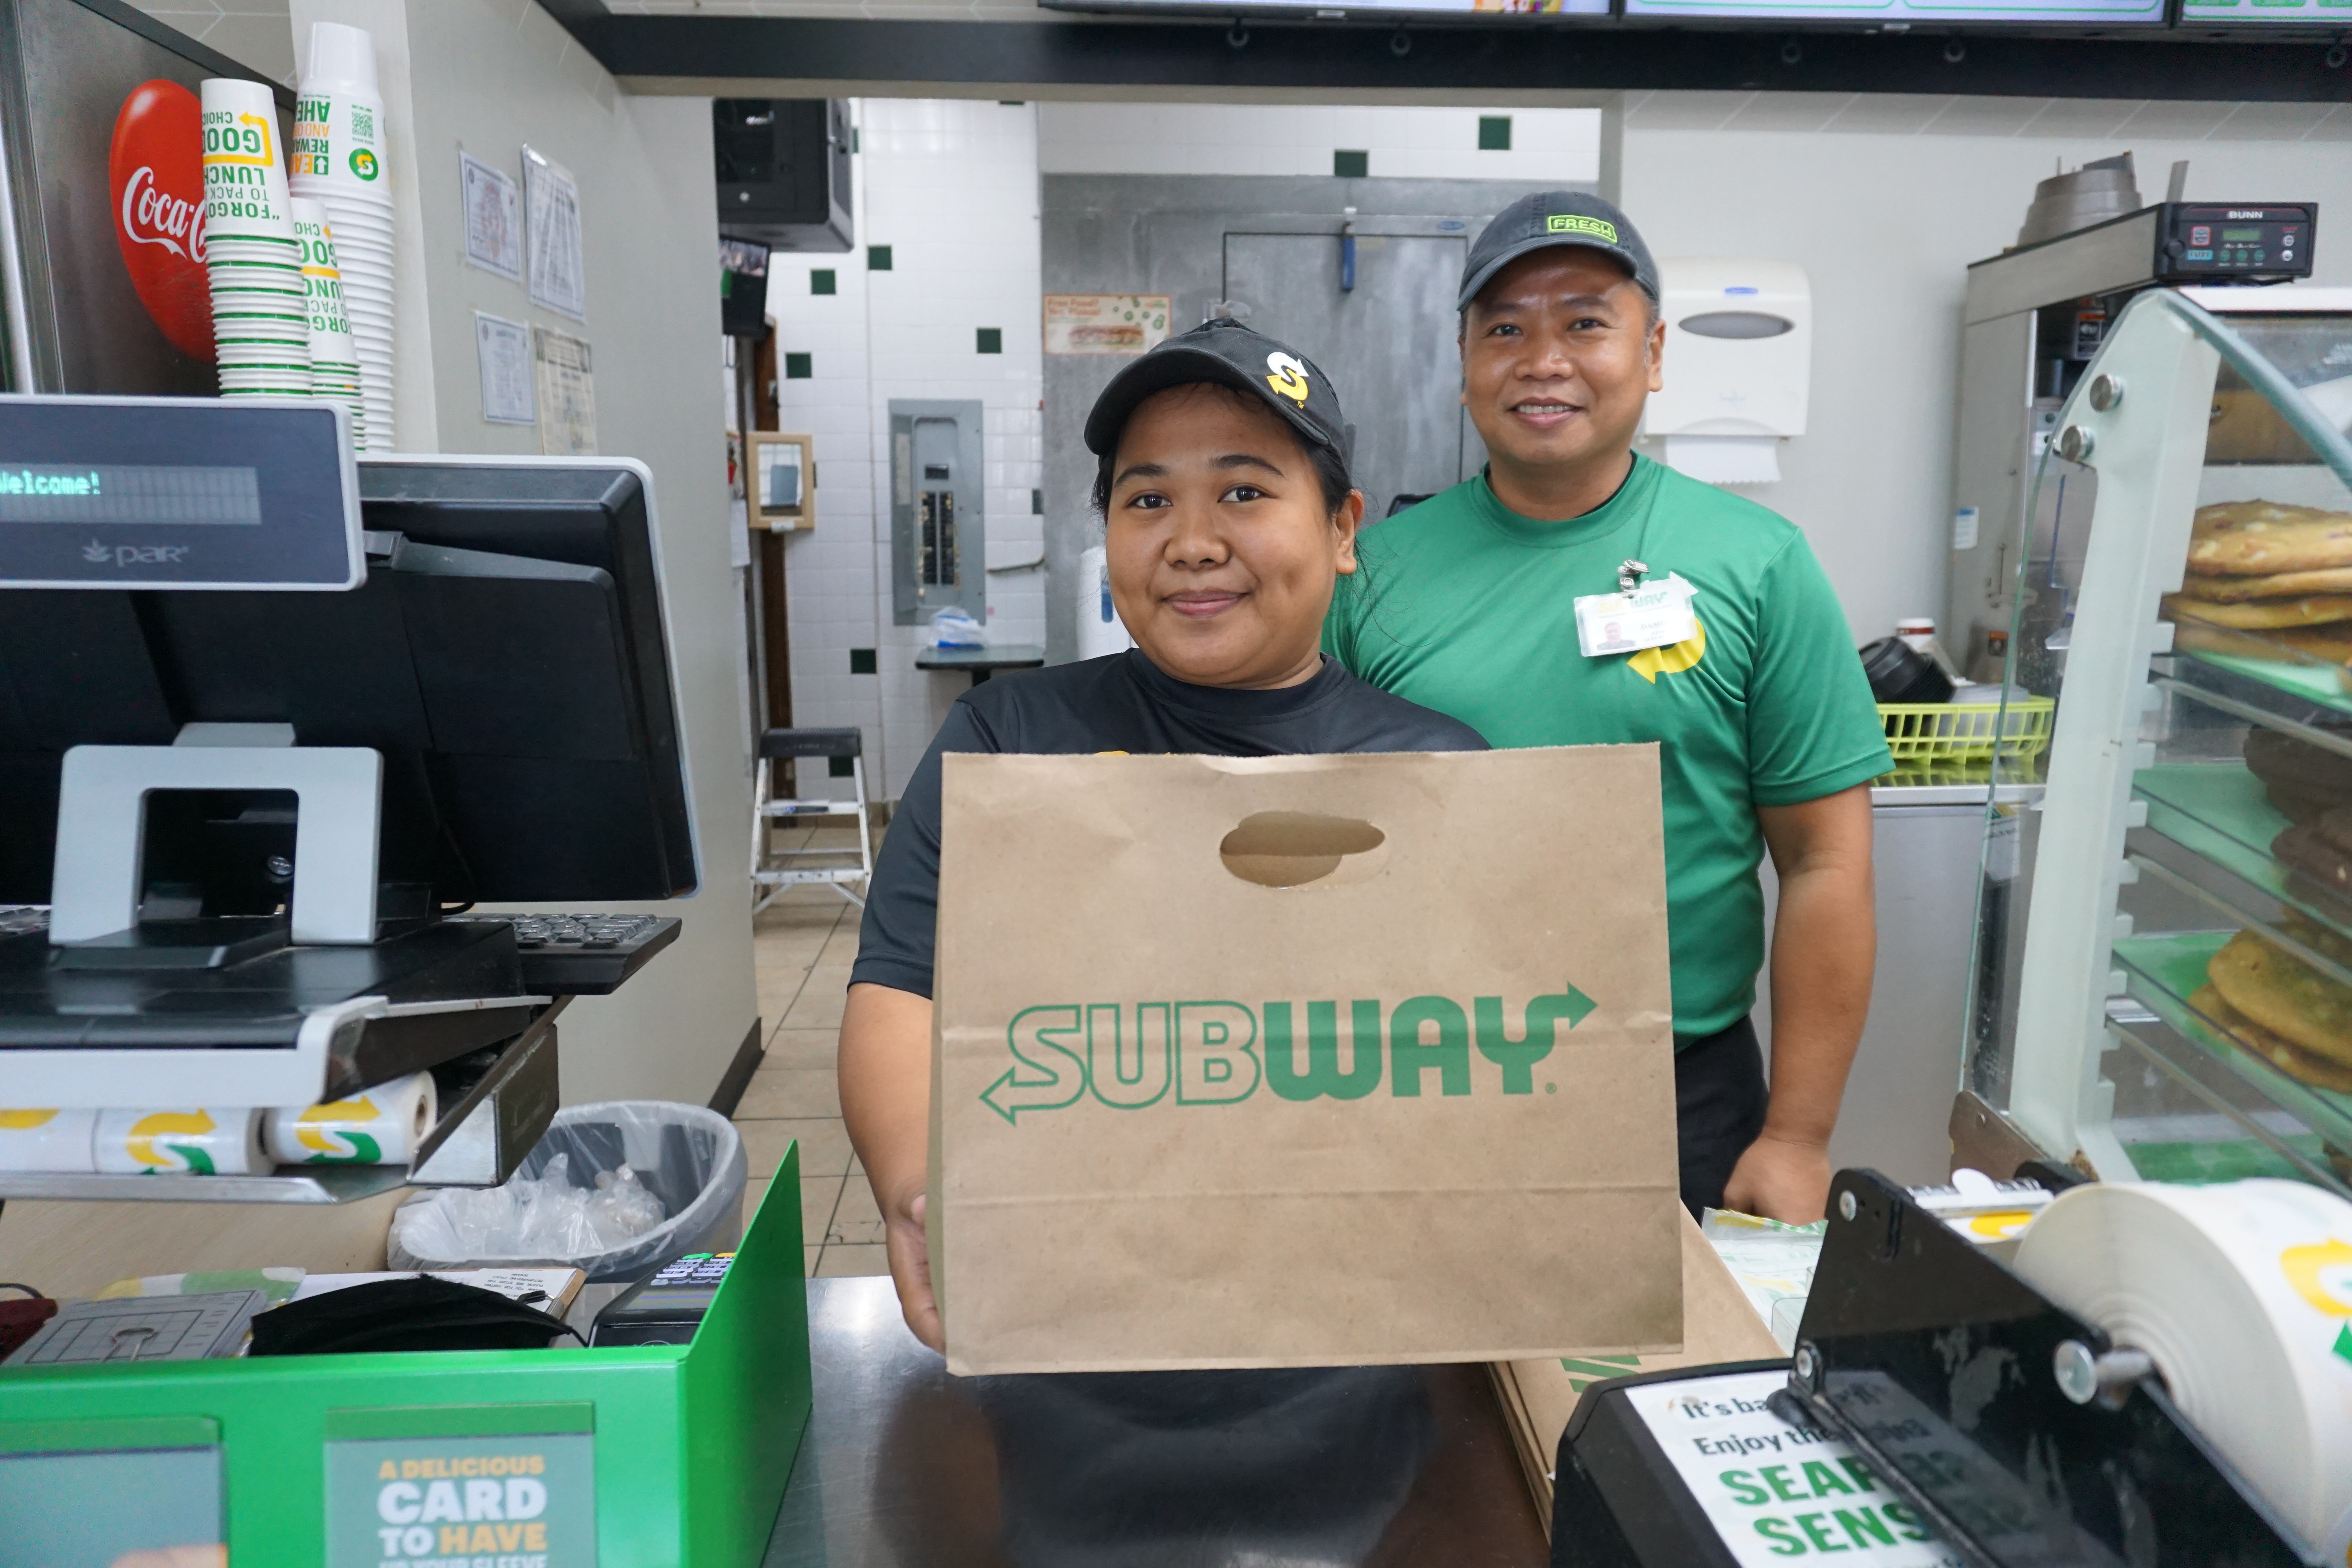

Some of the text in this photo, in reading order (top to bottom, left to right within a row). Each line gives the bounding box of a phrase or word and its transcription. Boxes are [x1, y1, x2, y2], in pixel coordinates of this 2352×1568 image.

[211, 186, 243, 199] PACK
[250, 189, 270, 201] TO
[2227, 211, 2263, 219] BUNN
[1553, 219, 1612, 237] FRESH
[980, 983, 1599, 1126] SUBWAY
[1681, 1400, 1732, 1419] It's
[1692, 1433, 1782, 1456] Enjoy
[378, 1455, 545, 1480] A DELICIOUS
[377, 1477, 548, 1524] CARD
[377, 1523, 547, 1557] TO HAVE
